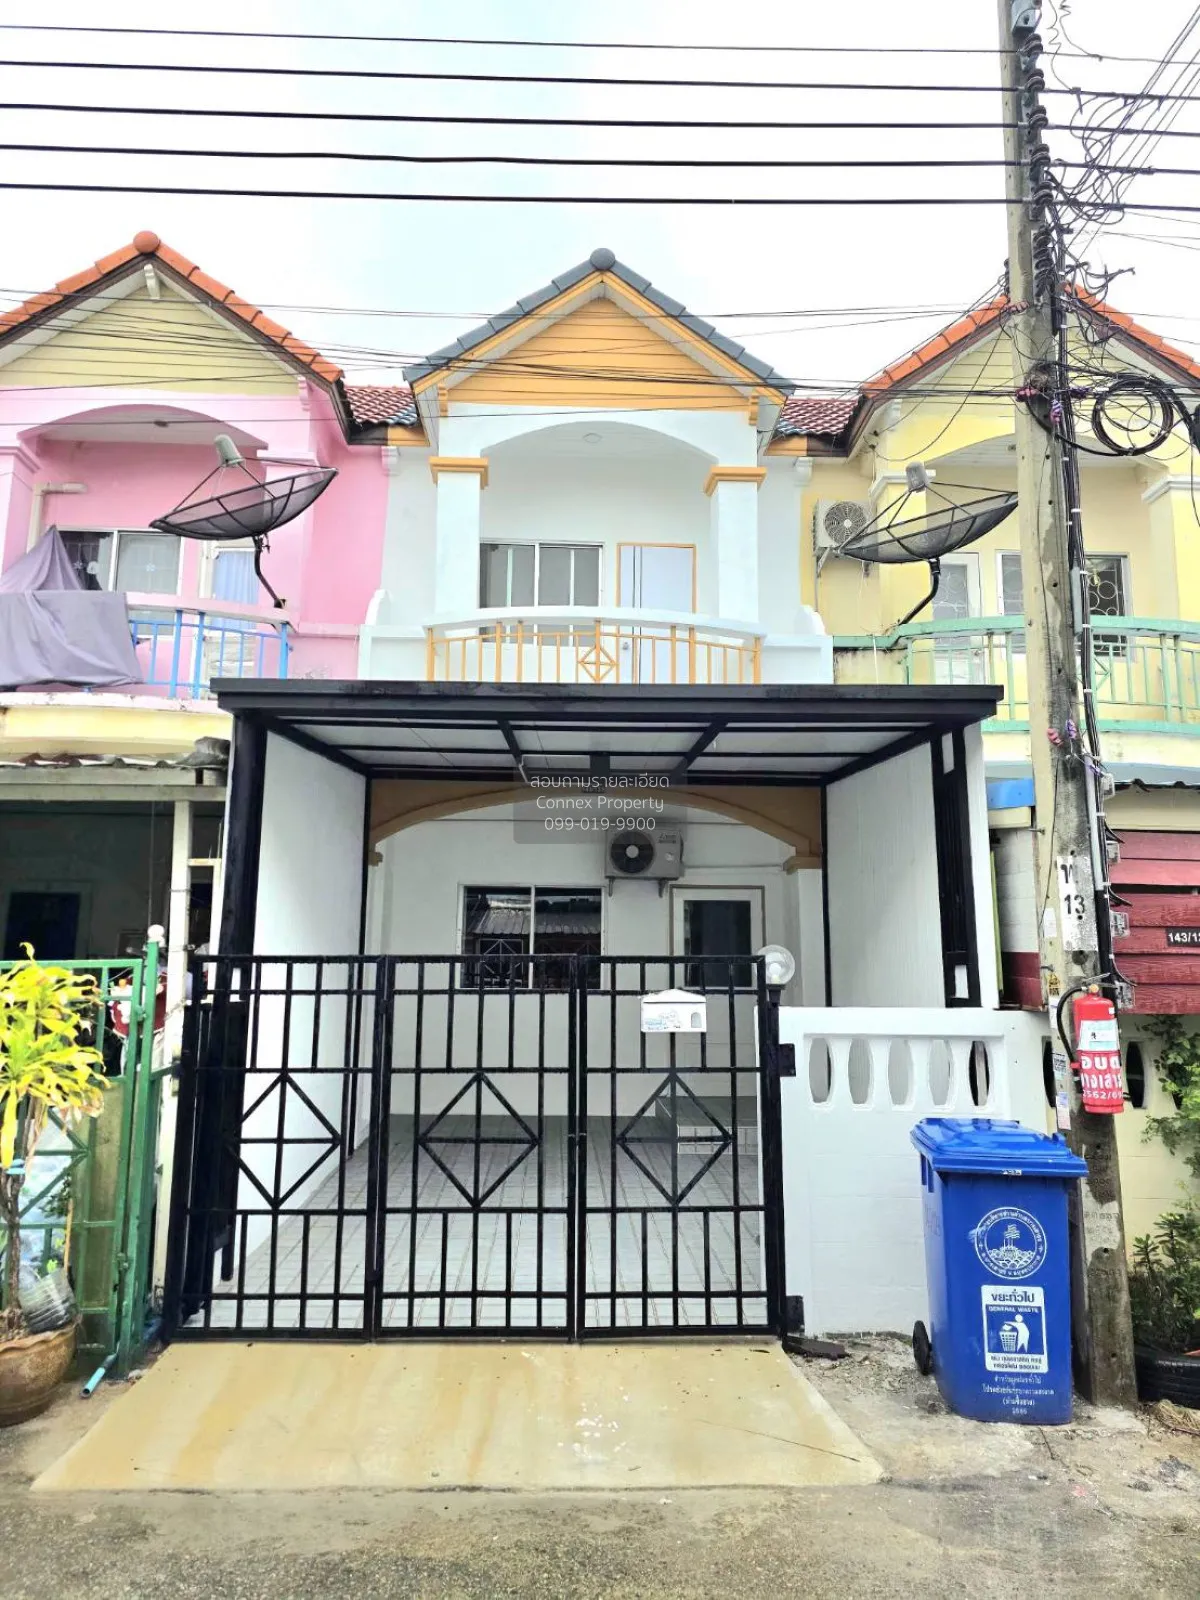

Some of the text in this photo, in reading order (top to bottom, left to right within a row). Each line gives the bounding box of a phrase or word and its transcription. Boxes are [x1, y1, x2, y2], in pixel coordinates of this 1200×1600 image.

[1064, 894, 1085, 915] 13
[1167, 932, 1200, 944] 143/1
[991, 1288, 1035, 1303] ขยะทั่วไป
